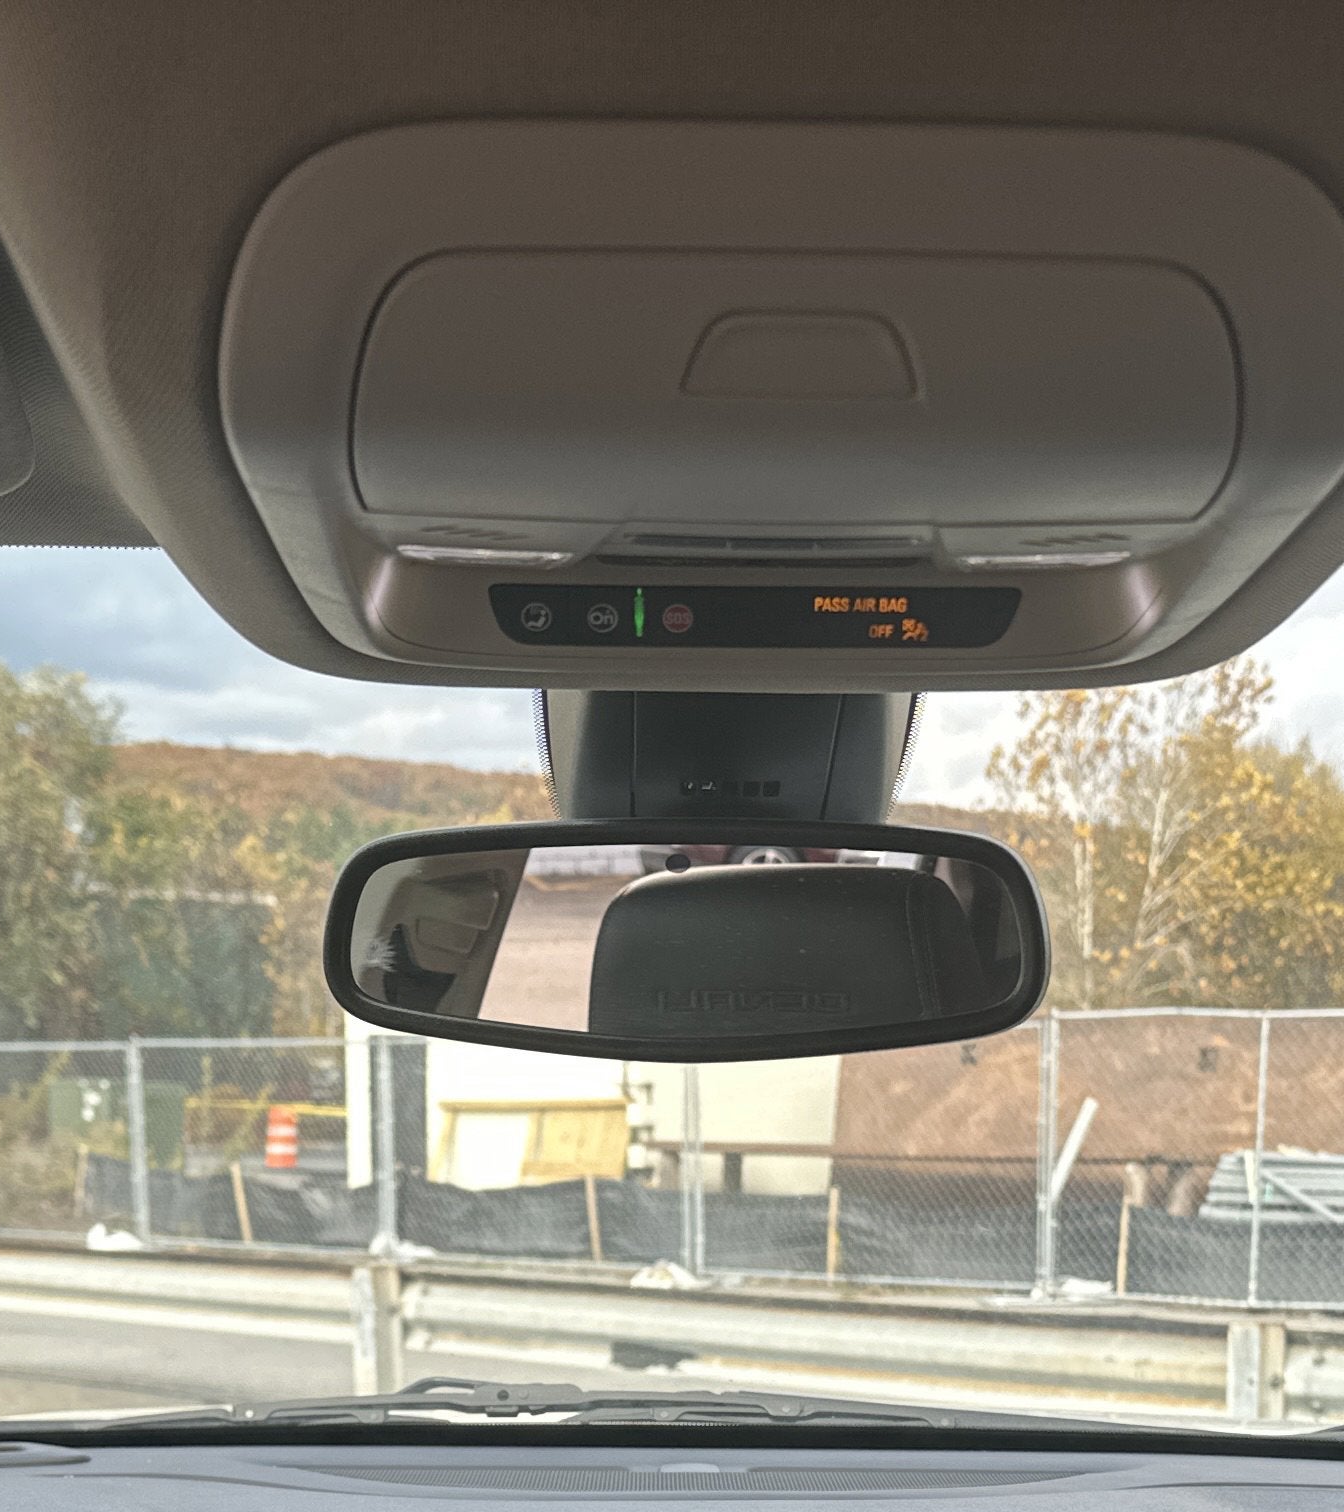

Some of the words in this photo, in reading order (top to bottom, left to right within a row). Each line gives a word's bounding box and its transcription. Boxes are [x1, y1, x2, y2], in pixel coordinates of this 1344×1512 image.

[814, 596, 850, 613] PASS
[853, 597, 876, 613] AIR
[878, 597, 908, 613] BAG
[589, 608, 617, 626] On
[664, 610, 693, 627] SOS
[868, 623, 894, 640] OFF
